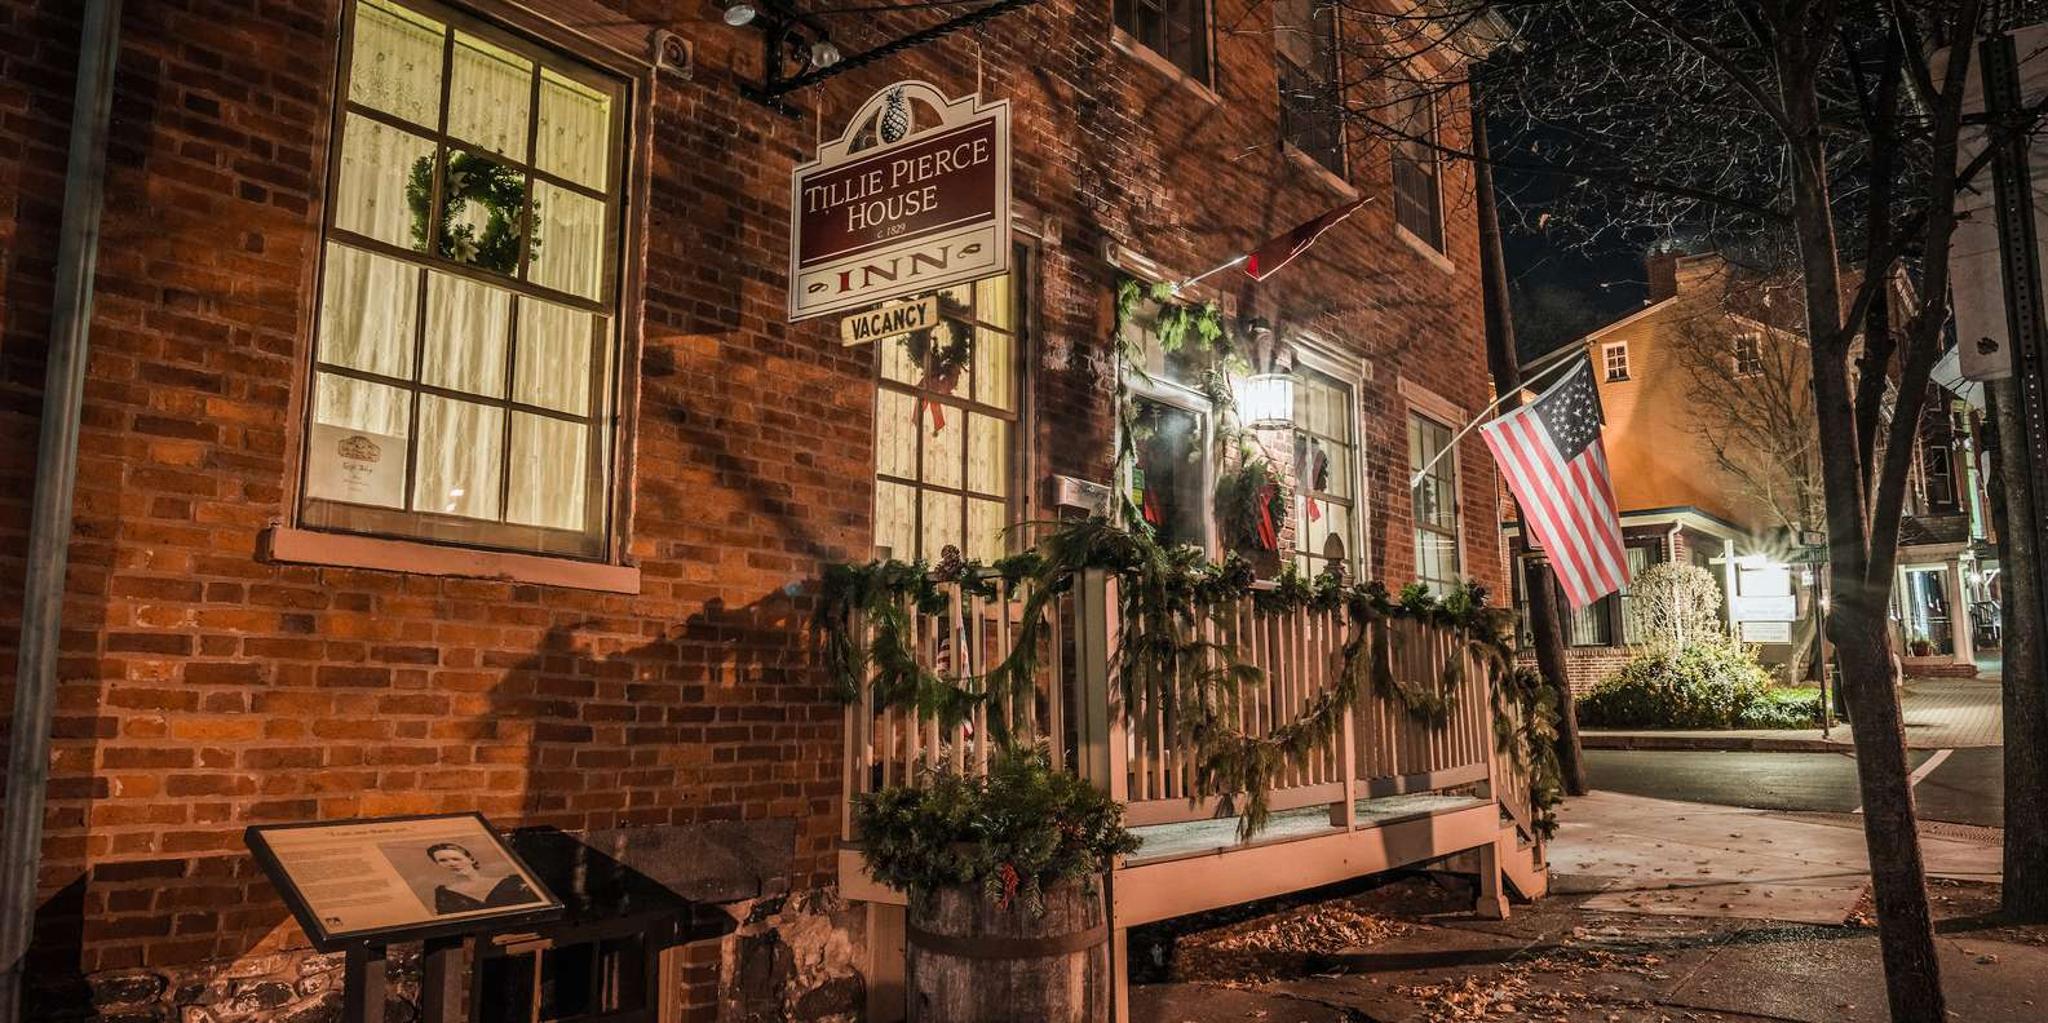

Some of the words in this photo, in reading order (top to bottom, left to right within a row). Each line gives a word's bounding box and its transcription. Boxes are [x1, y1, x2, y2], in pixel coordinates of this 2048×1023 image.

[804, 170, 884, 213] TILLIE
[891, 138, 989, 188] PIERCE
[847, 185, 938, 232] HOUSE
[887, 223, 906, 236] 1829
[838, 245, 952, 293] INN
[851, 304, 928, 340] VACANCY
